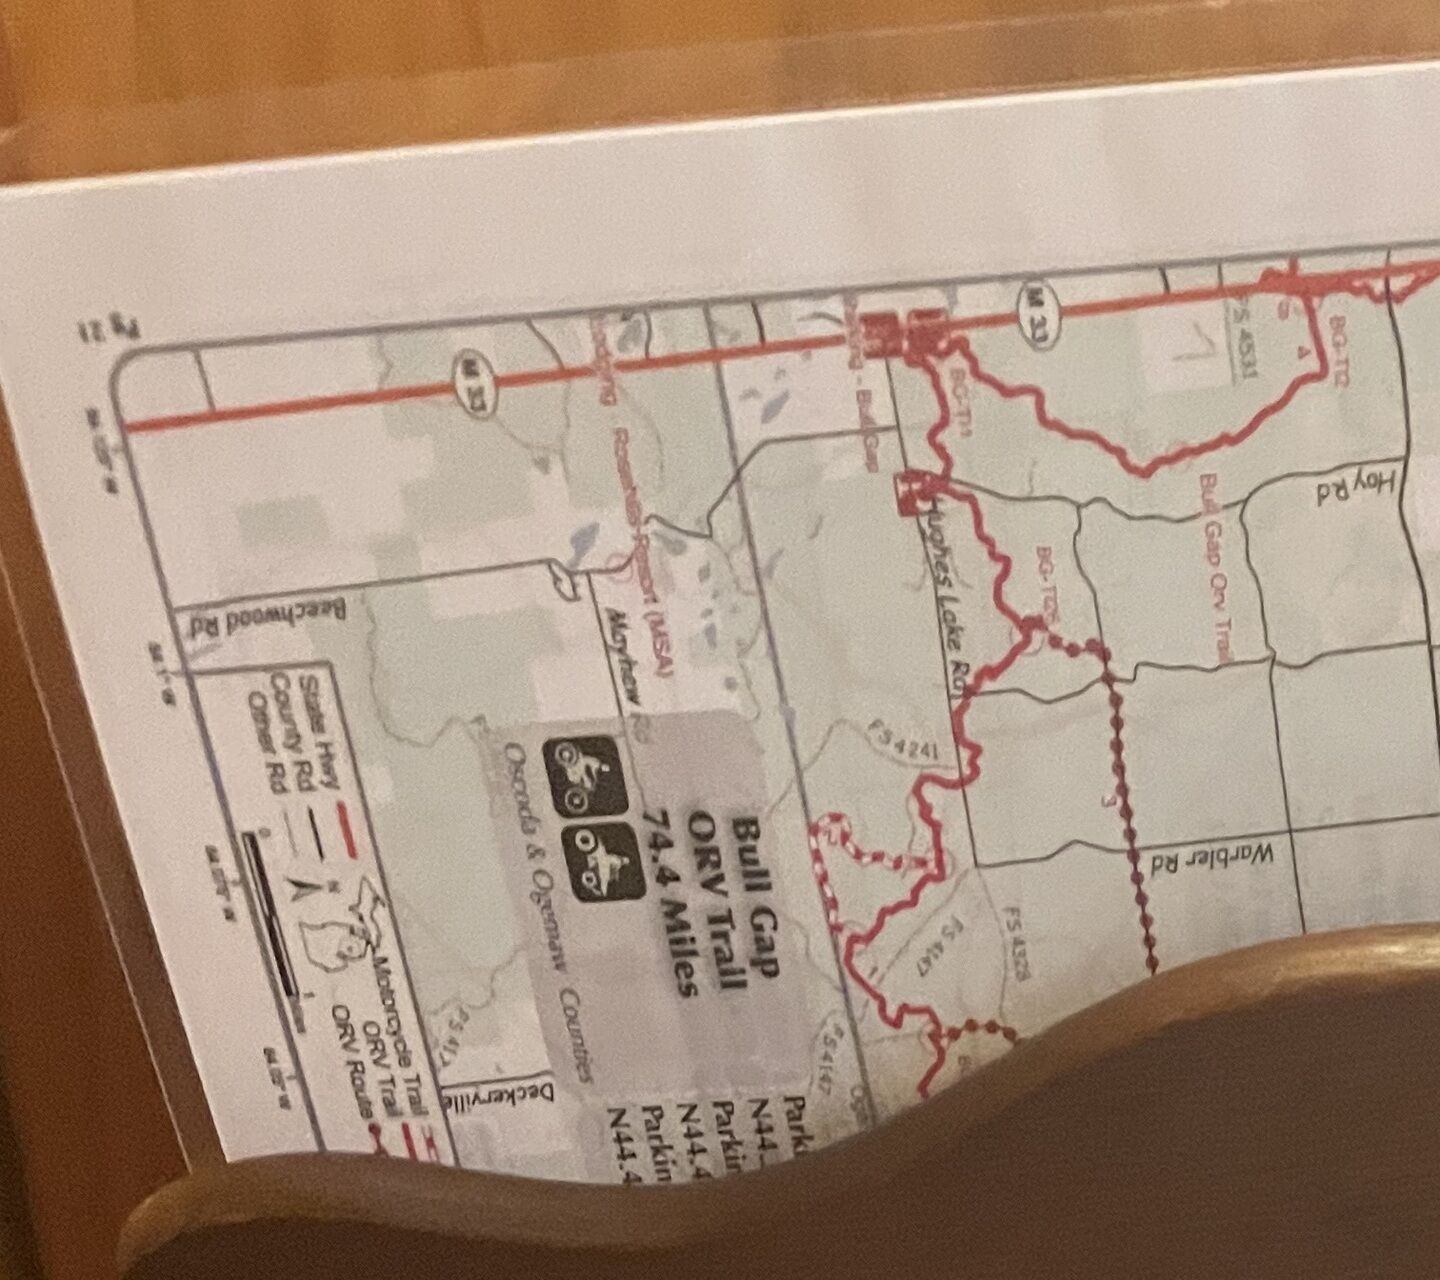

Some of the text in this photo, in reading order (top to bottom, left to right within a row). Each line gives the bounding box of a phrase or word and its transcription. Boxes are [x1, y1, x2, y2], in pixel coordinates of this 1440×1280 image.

[1025, 287, 1046, 307] M
[1315, 479, 1350, 508] Rd
[188, 596, 347, 639] Beechwood Rd
[939, 594, 971, 654] Lake
[247, 689, 288, 796] Other Rd
[270, 670, 317, 794] County Rd
[298, 675, 341, 792] State Hwy
[503, 740, 595, 1087] Oscoda & Ogemaw Counties
[642, 809, 700, 1001] 74.4 Miles
[686, 808, 749, 991] ORV Trail
[730, 816, 782, 980] Bull Gap
[1150, 842, 1275, 879] Warbler Rd
[330, 1002, 375, 1121] ORV Route
[362, 1018, 401, 1119] ORV Trail
[371, 954, 429, 1118] Motorcycle Trail
[440, 1080, 556, 1114] Deckerville
